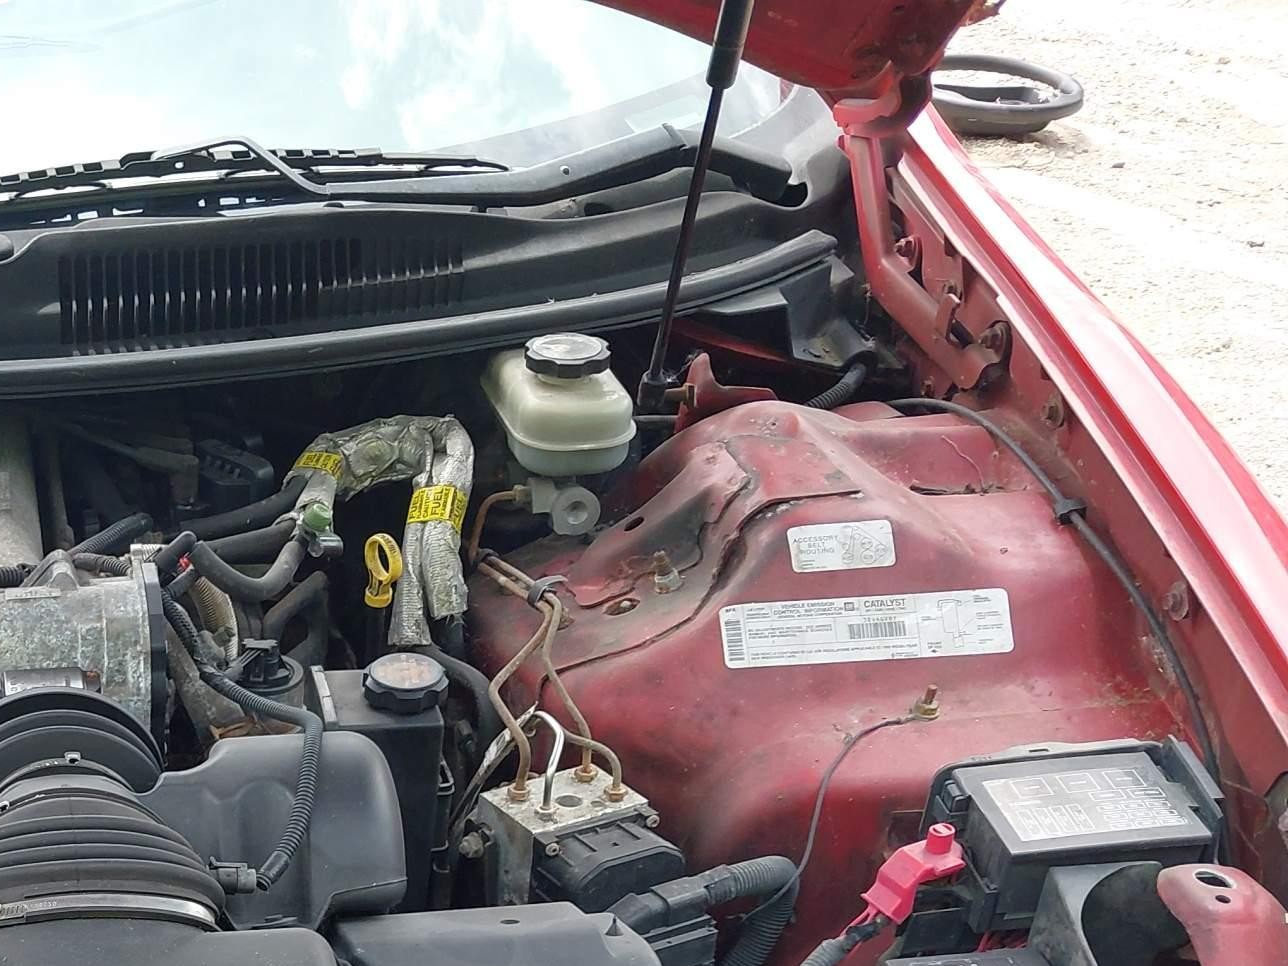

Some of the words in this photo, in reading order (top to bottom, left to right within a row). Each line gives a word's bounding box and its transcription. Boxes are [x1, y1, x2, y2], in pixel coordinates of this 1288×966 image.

[432, 488, 443, 515] FUEL
[792, 535, 838, 543] ACCESSORY
[800, 547, 834, 555] ROUTING
[863, 598, 905, 608] CATALYST
